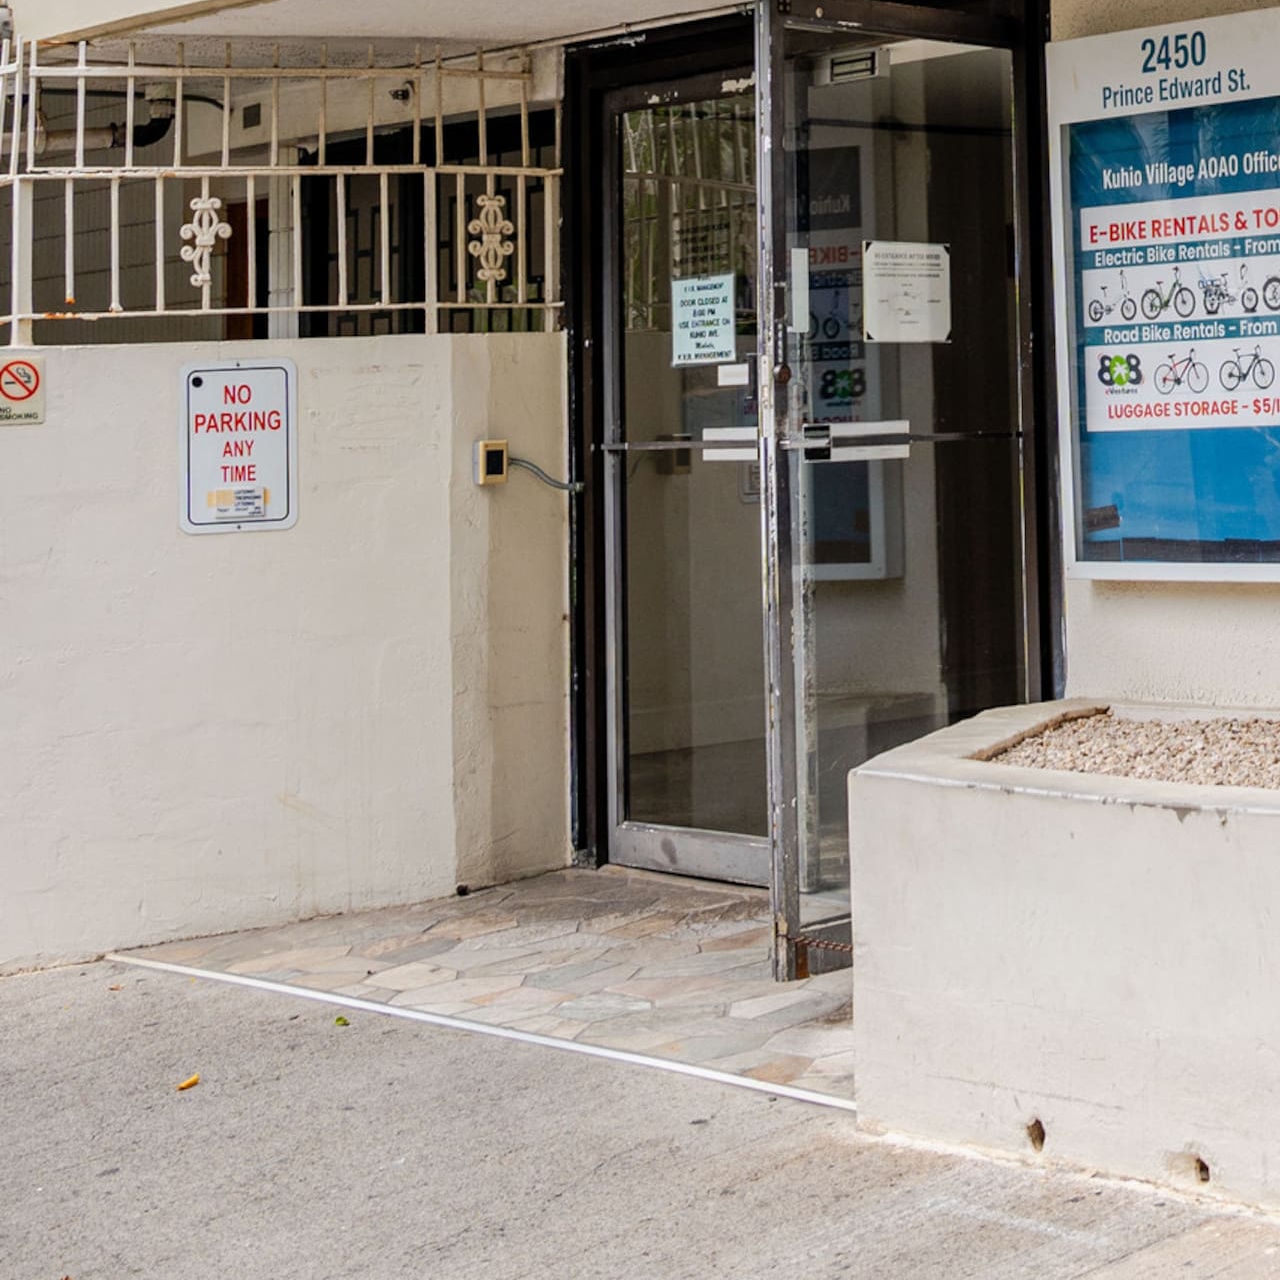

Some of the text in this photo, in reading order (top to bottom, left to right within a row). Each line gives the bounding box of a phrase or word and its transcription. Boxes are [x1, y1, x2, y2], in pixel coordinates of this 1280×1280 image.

[1141, 31, 1206, 73] 2450
[1102, 68, 1250, 109] Prince Edward St.
[1103, 166, 1142, 190] Kuhio
[1145, 162, 1195, 187] Village
[1197, 154, 1239, 180] AOAO
[1089, 220, 1147, 244] E-BIKE
[1152, 212, 1230, 238] RENTALS
[1234, 210, 1248, 231] &
[1095, 249, 1144, 267] Electric
[1147, 246, 1175, 263] Bike
[1178, 241, 1230, 260] Rentals
[1104, 328, 1139, 344] Road
[1141, 325, 1171, 341] Bike
[1173, 321, 1226, 340] Rentals
[1240, 318, 1277, 336] From
[223, 384, 251, 405] NO
[194, 410, 281, 433] PARKING
[1107, 403, 1170, 419] LUGGAGE
[1174, 400, 1238, 417] STORAGE
[222, 440, 254, 458] ANY
[220, 464, 257, 483] TIME
